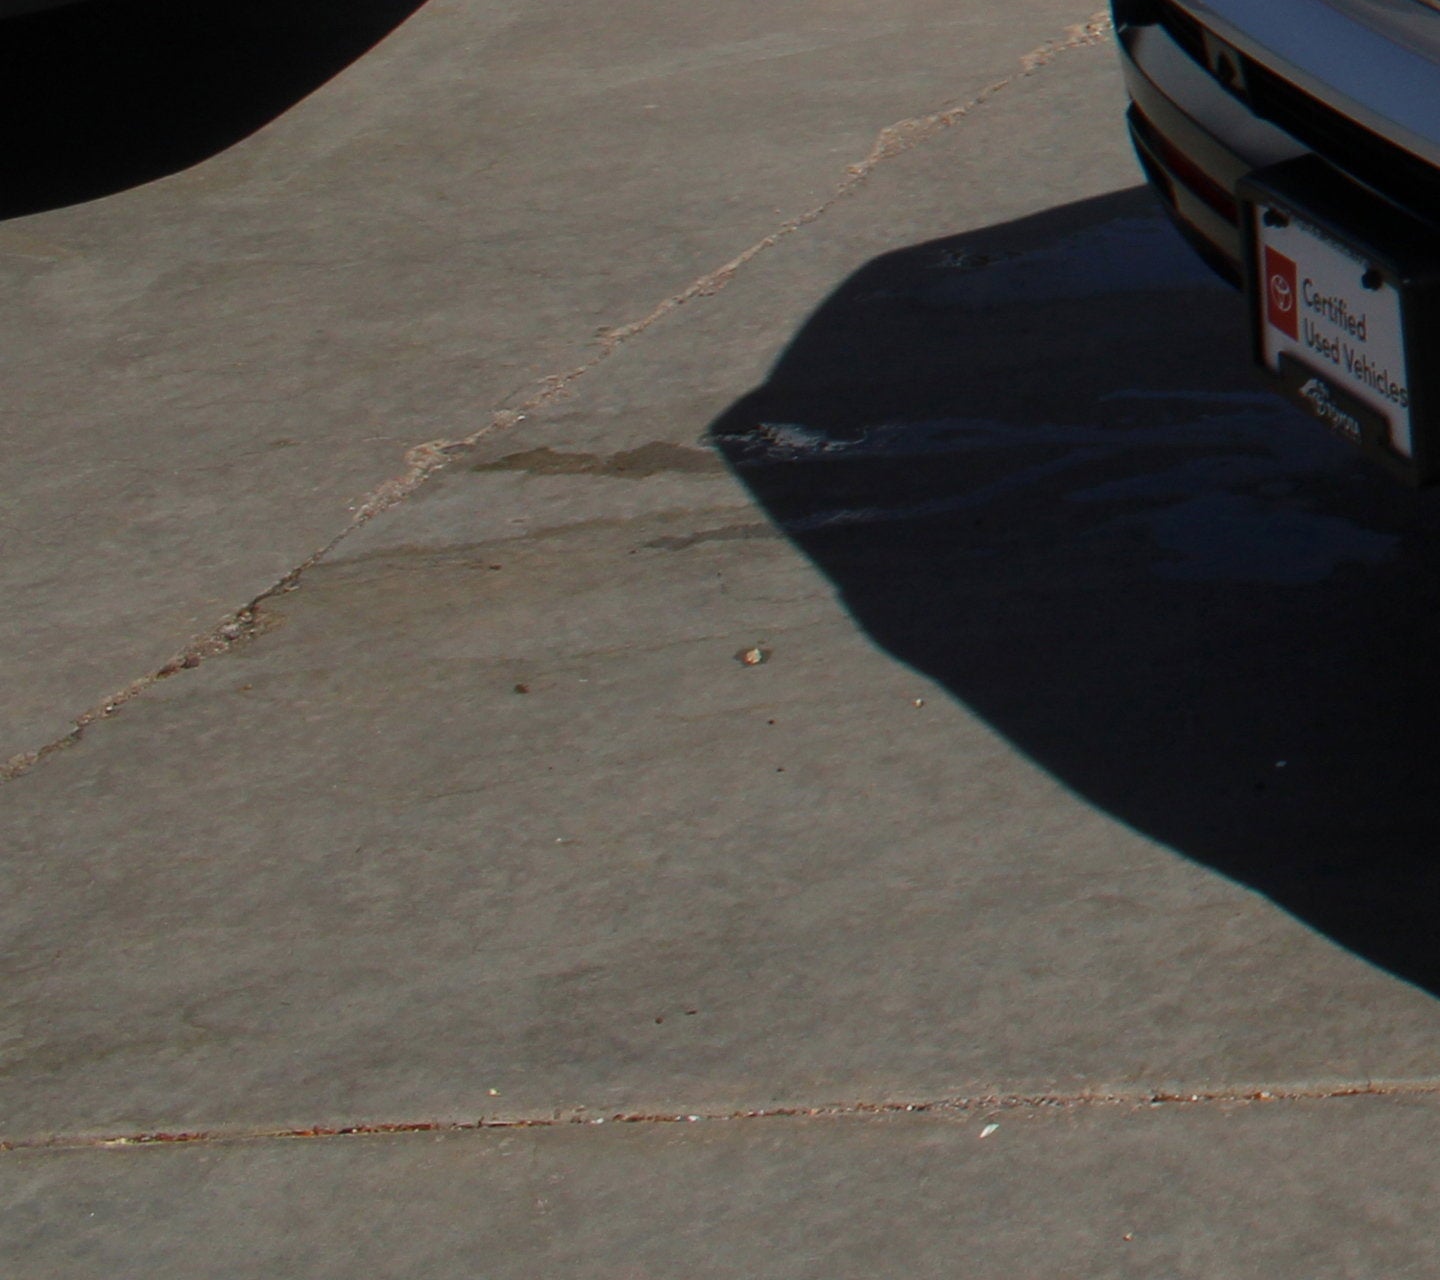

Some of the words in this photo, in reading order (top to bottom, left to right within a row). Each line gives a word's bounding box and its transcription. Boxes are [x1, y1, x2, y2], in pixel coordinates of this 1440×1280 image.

[1302, 277, 1367, 343] Certified
[1304, 317, 1340, 364] Used
[1342, 341, 1409, 408] Vehicles
